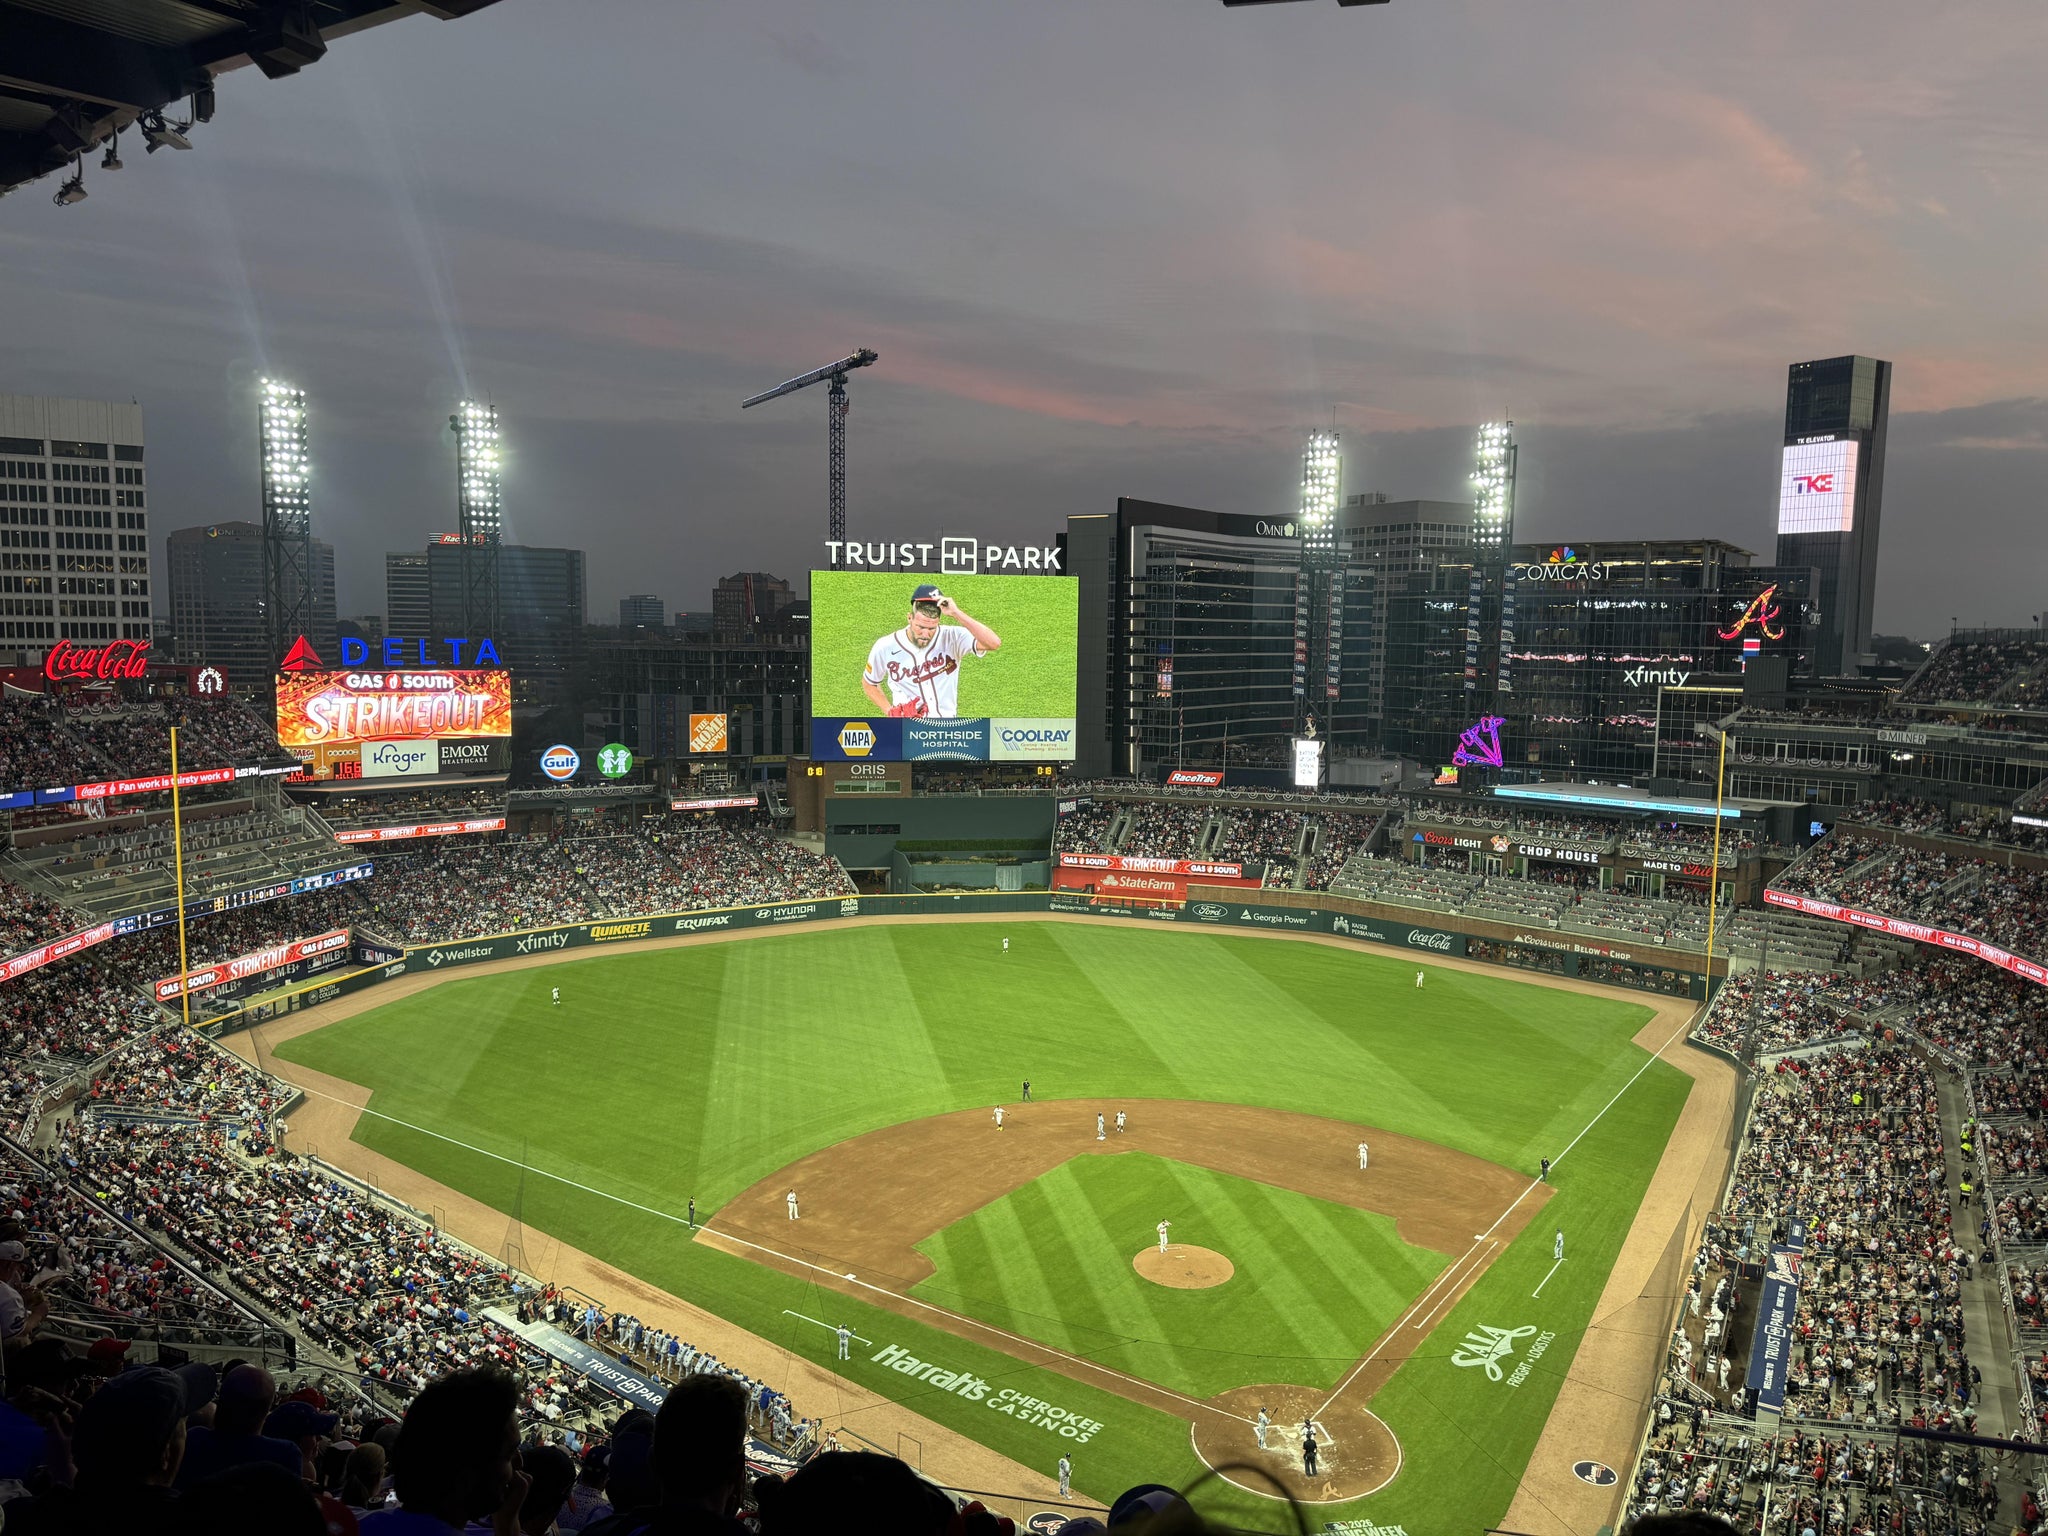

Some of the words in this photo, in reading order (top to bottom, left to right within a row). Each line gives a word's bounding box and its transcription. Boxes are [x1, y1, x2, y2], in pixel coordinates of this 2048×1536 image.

[1806, 435, 1835, 444] ELEVATOR
[1793, 474, 1833, 494] TKE
[1256, 521, 1283, 536] OMNI
[825, 541, 933, 567] TRUIST
[986, 546, 1062, 569] PARK
[1514, 565, 1611, 581] COMCAST
[342, 637, 502, 665] DELTA
[46, 639, 151, 680] Coca-Cola
[346, 674, 383, 689] GAS
[403, 674, 454, 689] SOUTH
[1623, 666, 1690, 687] xfinity
[304, 695, 490, 740] STRIKEOUT
[691, 714, 727, 752] HOME
[694, 718, 709, 734] THE
[704, 729, 727, 751] DEPOT
[844, 732, 871, 747] NAPA
[909, 731, 982, 740] NORTHSIDE
[1002, 730, 1071, 742] COOLRAY
[1888, 731, 1925, 744] MILNER
[373, 744, 426, 772] Kroger
[441, 744, 490, 758] EMORY
[441, 757, 488, 765] HEALTHCARE
[543, 757, 575, 769] Gulf
[851, 764, 885, 775] ORIS
[82, 785, 106, 796] Coca-Cola
[119, 782, 136, 791] Fan
[139, 780, 160, 790] work
[162, 776, 168, 786] is
[170, 774, 199, 786] tirsty
[200, 772, 221, 782] work
[1171, 773, 1218, 784] RaceTrac
[205, 815, 268, 833] TERRACE
[380, 828, 418, 838] STRIKEOUT
[465, 820, 500, 830] STRIKEOUT
[121, 848, 163, 863] HANK
[229, 826, 291, 843] TERRACE
[1424, 831, 1453, 846] Coors
[1454, 838, 1482, 849] LIGHT
[1519, 845, 1552, 858] CHOP
[1556, 849, 1599, 863] HOUSE
[1086, 858, 1109, 866] SOUTH
[1121, 857, 1178, 873] STRIKEOUT
[1213, 867, 1239, 875] SOUTH
[1643, 860, 1666, 870] MADE
[1669, 863, 1681, 872] TO
[1119, 876, 1147, 889] State
[1148, 879, 1176, 890] Farm
[773, 905, 816, 916] HYUNDAI
[840, 904, 859, 912] JOHNS
[841, 898, 858, 907] PAPA
[1198, 905, 1222, 917] Ford
[1253, 912, 1283, 924] Georgia
[1284, 915, 1308, 925] Power
[590, 922, 651, 938] QUIKRETE
[675, 916, 730, 930] EQUIFAX
[1351, 922, 1368, 930] KAISER
[1408, 929, 1454, 951] Coca-Cola
[1802, 901, 1841, 917] STRIKEOUT
[1887, 922, 1933, 941] STRIKEOUT
[1943, 936, 1956, 945] GAS
[1979, 945, 2011, 966] STRIKEOUT
[517, 931, 570, 953] xfinity
[1524, 934, 1548, 947] Coors
[1548, 942, 1570, 951] LIGHT
[322, 948, 345, 965] MLB+
[446, 946, 493, 961] Wellstar
[1574, 944, 1601, 956] BELOW
[1610, 950, 1631, 960] CHOP
[9, 949, 46, 977] STRIKEOUT
[160, 982, 179, 996] GAS
[188, 972, 216, 989] SOUTH
[229, 947, 289, 979] STRIKEOUT
[302, 943, 317, 955] GAS
[323, 934, 346, 949] SOUTH
[216, 981, 242, 997] MLB+
[319, 984, 336, 994] SOUTH
[319, 988, 340, 1000] COLLEGE
[1770, 1308, 1785, 1328] PARK
[1764, 1335, 1781, 1360] TRUIST
[1506, 1360, 1532, 1388] FREIGHT
[1529, 1330, 1556, 1360] LOGISTICS
[585, 1358, 628, 1382] TRUIST
[871, 1343, 993, 1401] Harrah's
[998, 1388, 1105, 1434] CHEROKEE
[986, 1397, 1093, 1444] CASINOS
[1348, 1519, 1374, 1529] 2026
